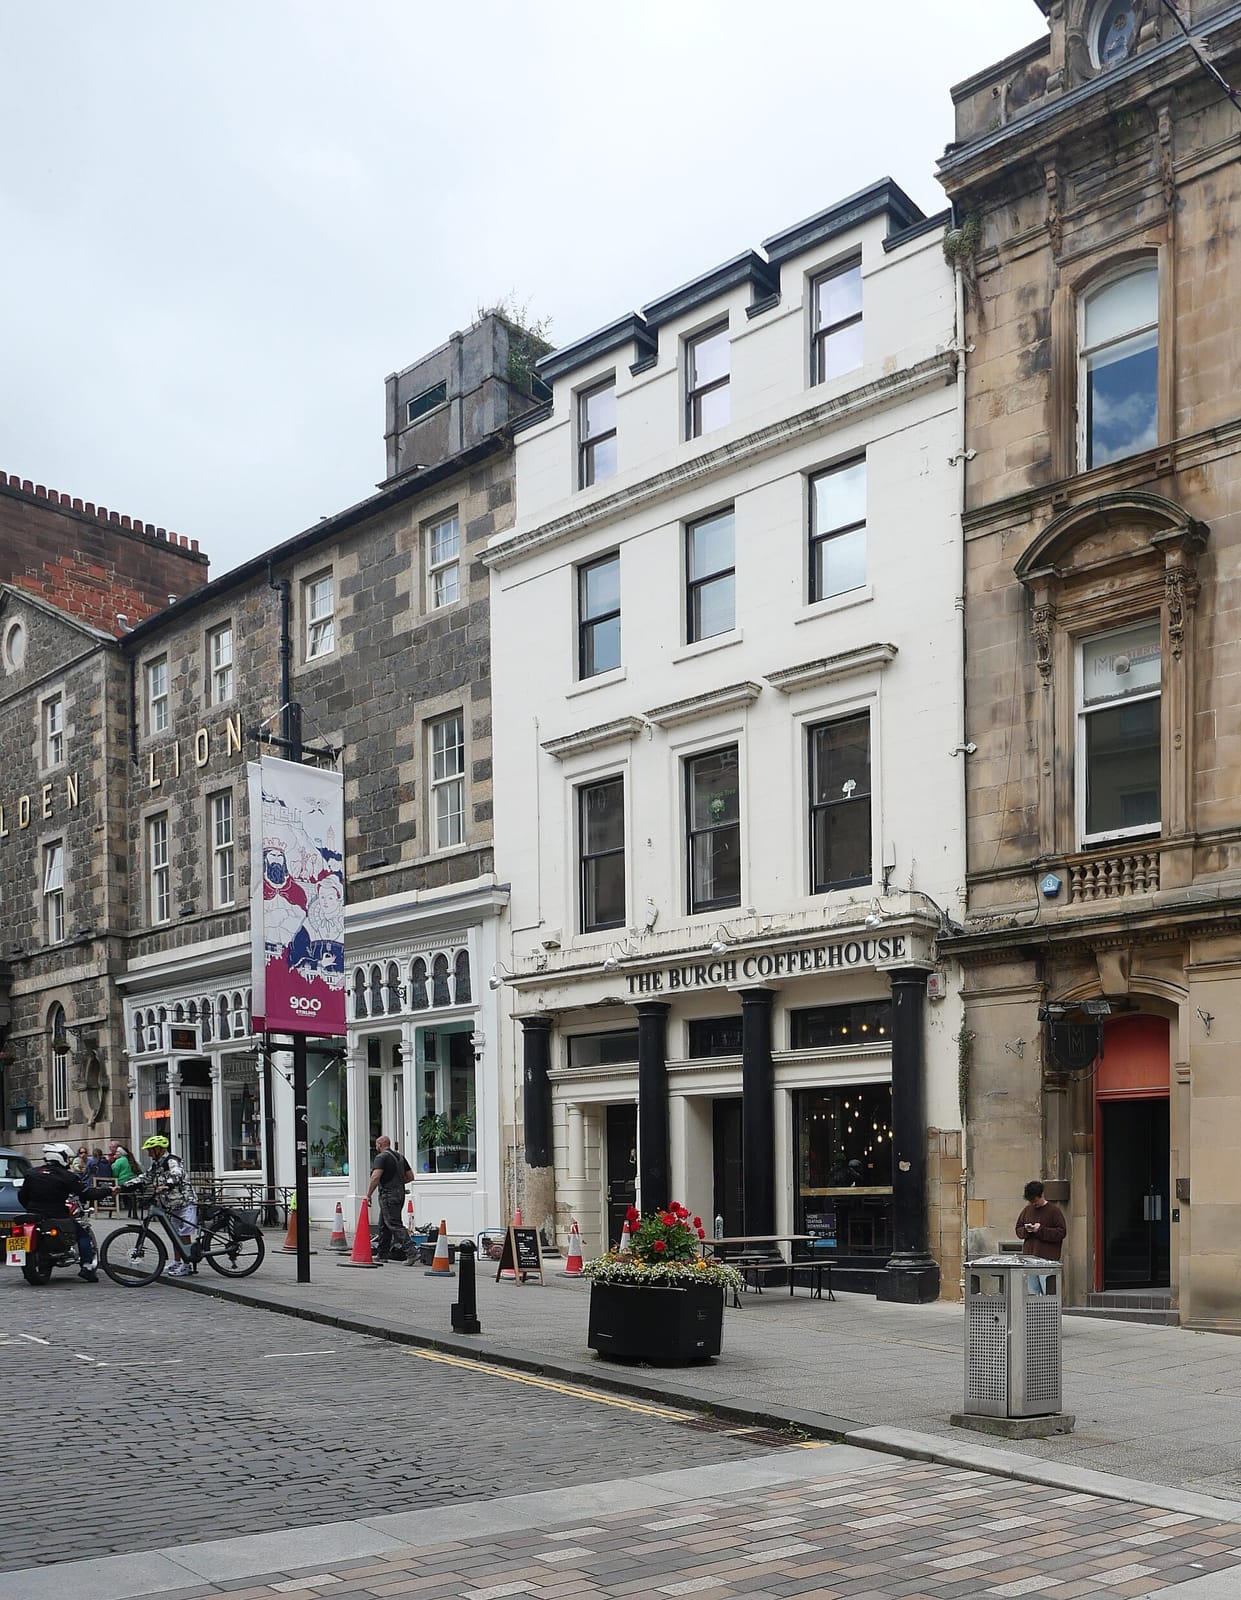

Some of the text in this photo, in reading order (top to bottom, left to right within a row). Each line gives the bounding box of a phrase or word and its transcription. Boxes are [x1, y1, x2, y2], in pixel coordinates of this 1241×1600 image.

[150, 713, 241, 788] LION
[626, 936, 906, 994] THE BURGH COFFEEHOUSE
[289, 995, 322, 1011] 900
[11, 1254, 21, 1263] L
